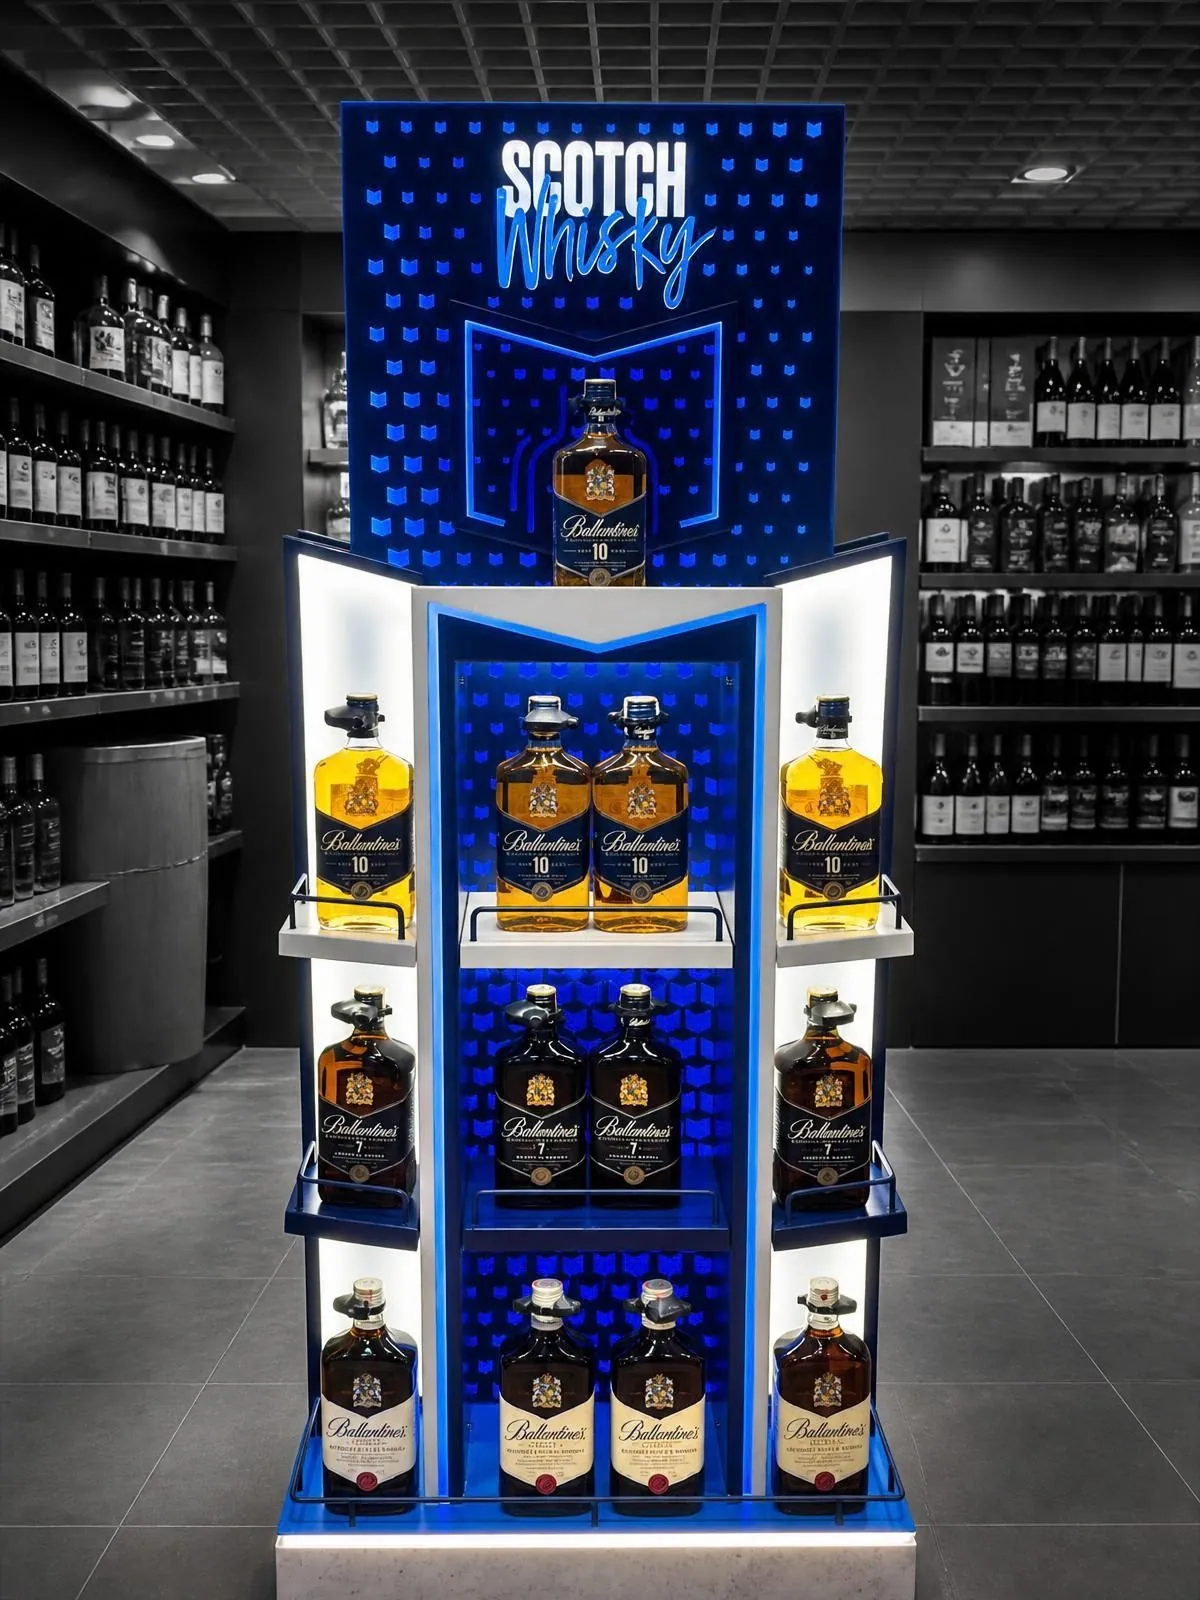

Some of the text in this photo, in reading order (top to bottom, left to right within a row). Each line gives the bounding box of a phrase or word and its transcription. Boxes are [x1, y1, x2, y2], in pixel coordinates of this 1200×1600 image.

[502, 139, 687, 217] SCOTCH
[496, 173, 718, 309] Whisky
[592, 542, 608, 561] 10
[351, 856, 368, 874] 10
[532, 856, 549, 874] 10
[632, 857, 648, 874] 10
[824, 856, 841, 874] 10
[356, 1141, 363, 1153] 7
[538, 1142, 545, 1155] 7
[630, 1142, 637, 1155] 7
[824, 1143, 832, 1155] 7
